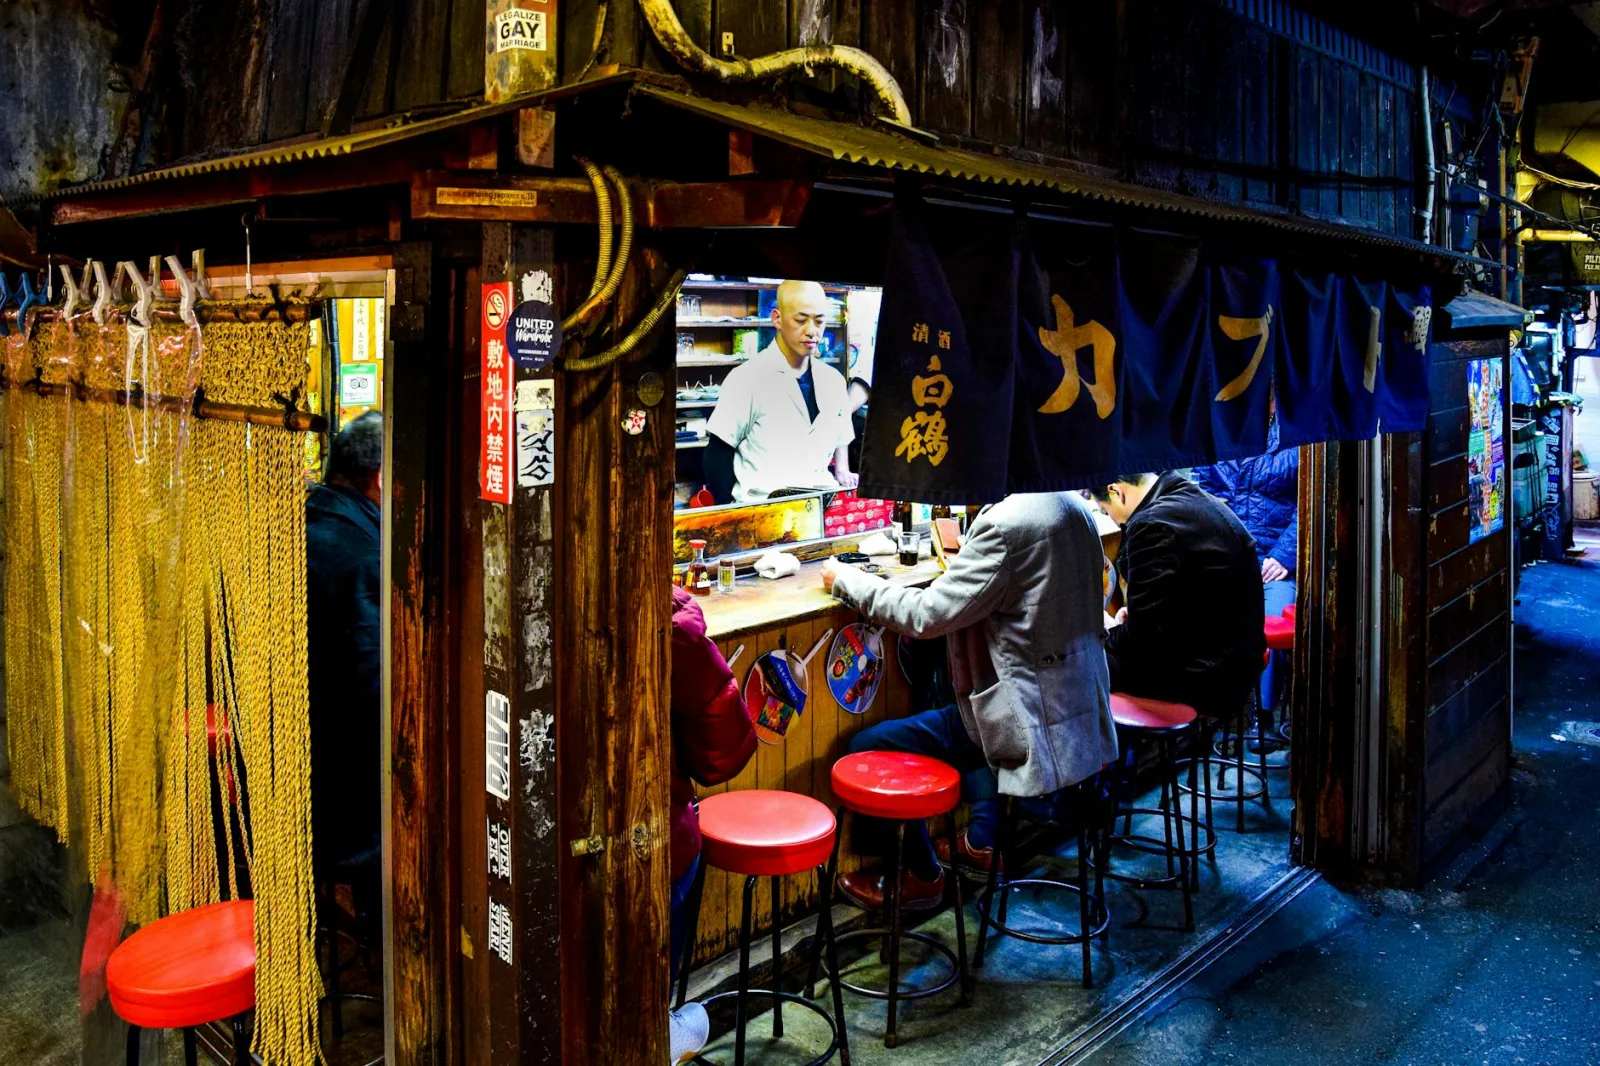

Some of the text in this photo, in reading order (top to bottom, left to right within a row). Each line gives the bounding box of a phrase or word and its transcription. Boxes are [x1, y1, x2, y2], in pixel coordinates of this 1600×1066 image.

[500, 11, 541, 21] LEGALIZE
[501, 20, 539, 39] GAY
[500, 39, 541, 49] MARRIAGE
[515, 317, 554, 331] UNITED
[486, 339, 504, 495] 敷地内禁煙
[894, 354, 954, 467] 白鶴
[500, 829, 510, 878] OVER
